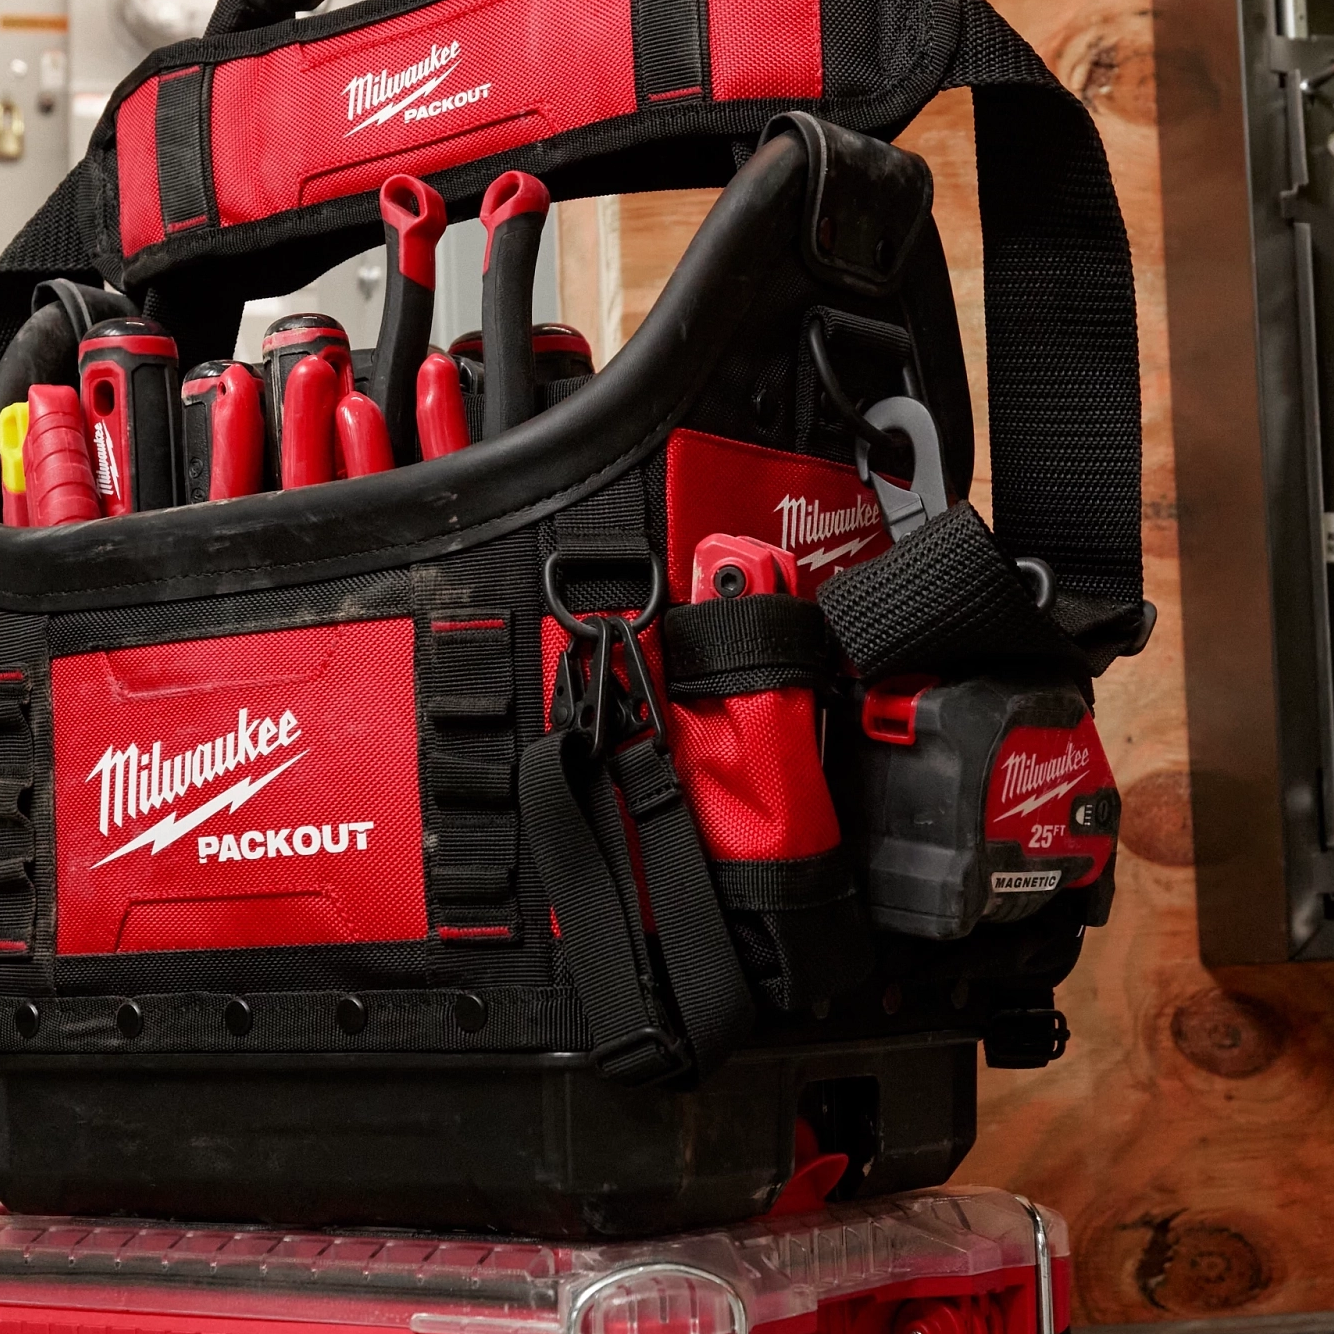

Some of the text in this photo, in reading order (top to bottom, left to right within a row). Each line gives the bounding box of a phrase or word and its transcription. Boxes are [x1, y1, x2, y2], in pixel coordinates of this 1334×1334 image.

[340, 40, 462, 121] Milwaukee
[404, 82, 492, 124] PACKOUT
[93, 422, 114, 499] Milwaukee
[773, 493, 880, 551] Milwaukee
[84, 707, 302, 837] Milwaukee
[1001, 742, 1091, 804] Milwaukee
[197, 820, 375, 864] PACKOUT
[994, 875, 1057, 888] MAGNETIC
